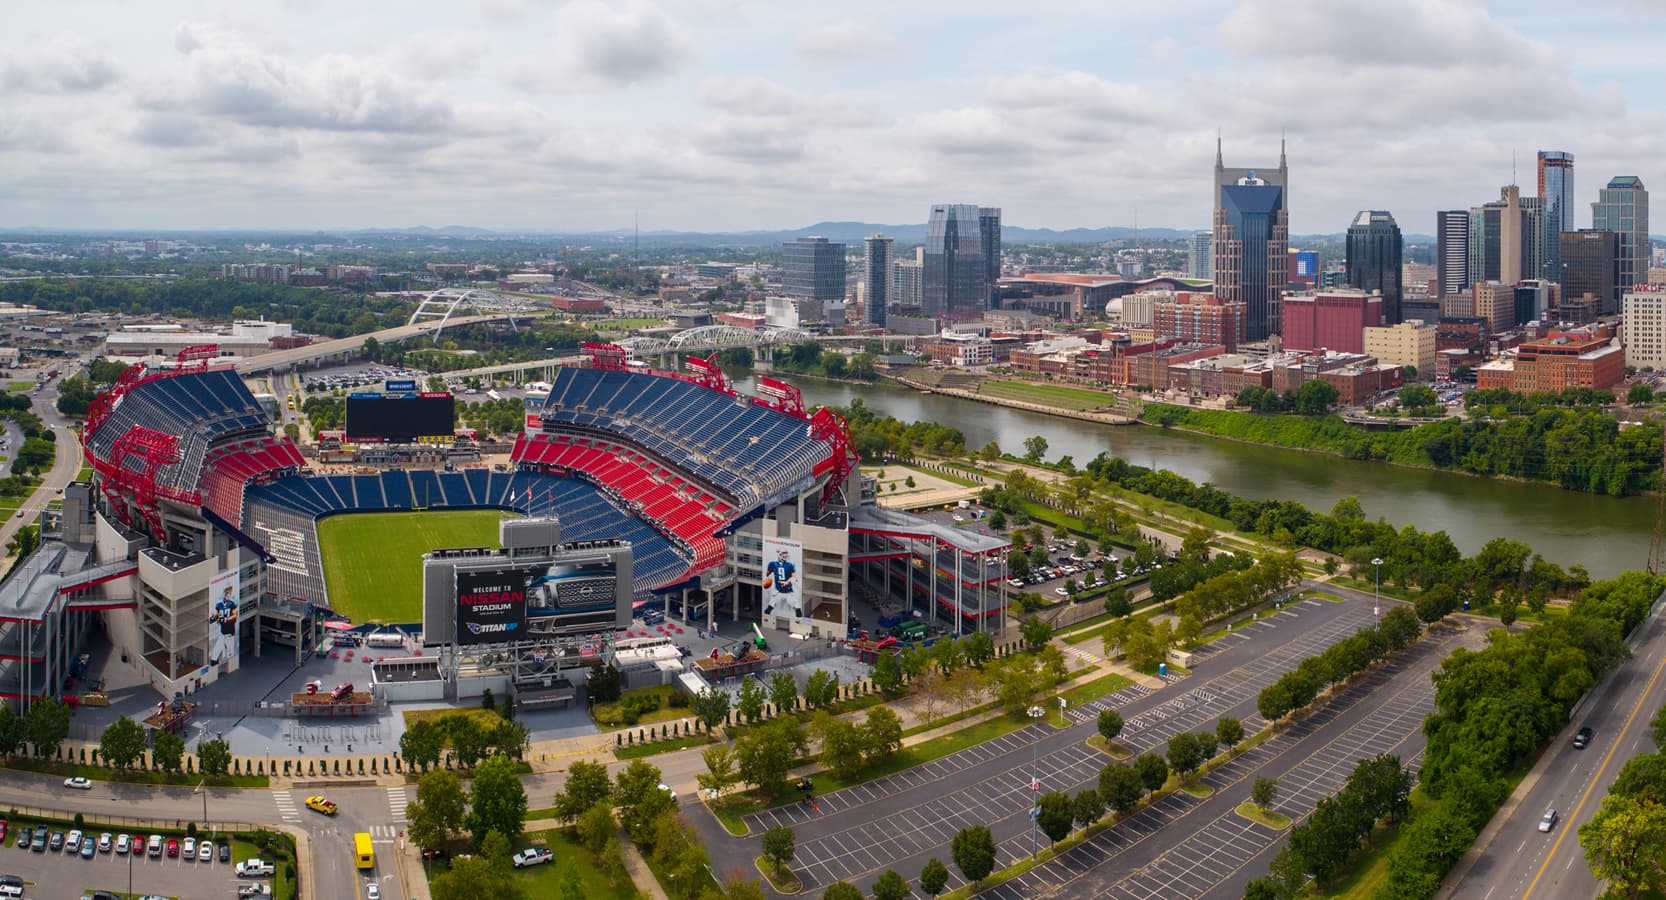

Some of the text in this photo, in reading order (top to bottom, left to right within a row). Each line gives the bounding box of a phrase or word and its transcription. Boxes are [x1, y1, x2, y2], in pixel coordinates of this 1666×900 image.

[777, 567, 786, 580] 9
[461, 592, 523, 605] NISSAN
[472, 603, 511, 612] STADIUM
[305, 682, 316, 696] 3
